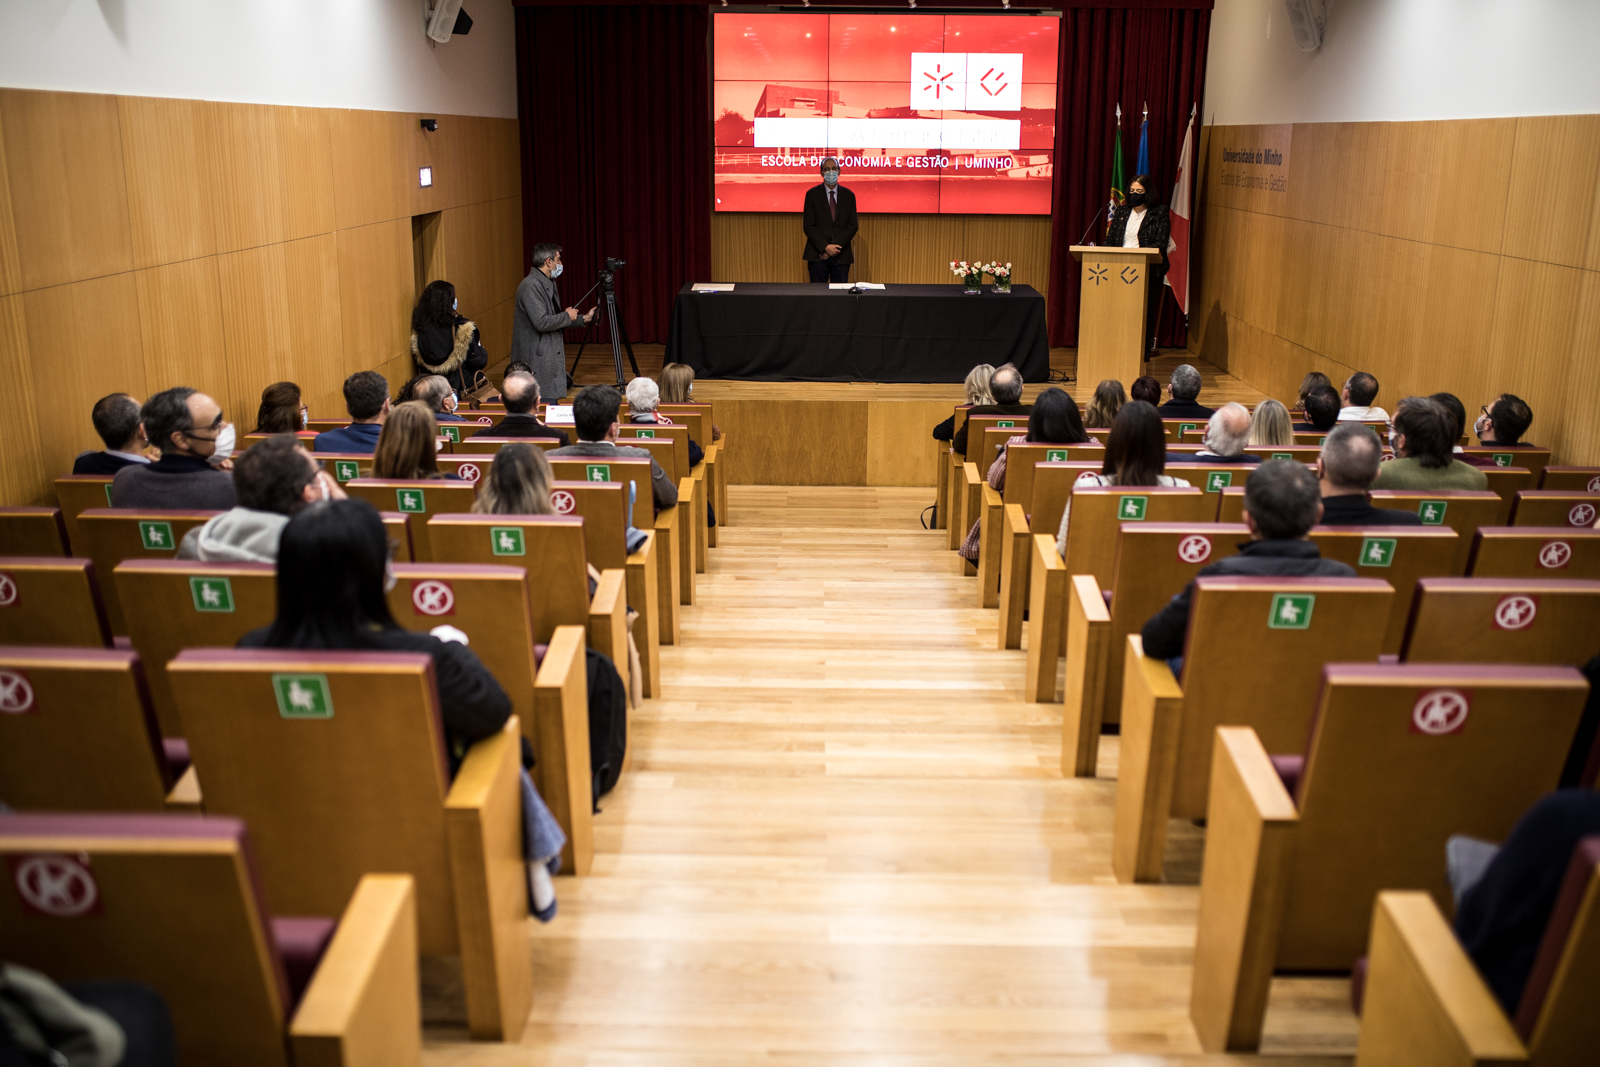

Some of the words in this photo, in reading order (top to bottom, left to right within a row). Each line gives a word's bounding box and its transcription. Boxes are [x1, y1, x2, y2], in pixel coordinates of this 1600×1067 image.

[761, 155, 806, 167] ESCOLA
[831, 156, 891, 167] CONOMIA
[895, 156, 903, 168] E
[906, 155, 949, 168] GESTÃO
[964, 157, 1012, 169] UMINHO
[1223, 148, 1255, 164] Universidade
[1256, 148, 1263, 164] do
[1264, 149, 1282, 166] Minho
[1269, 173, 1286, 192] Gestão
